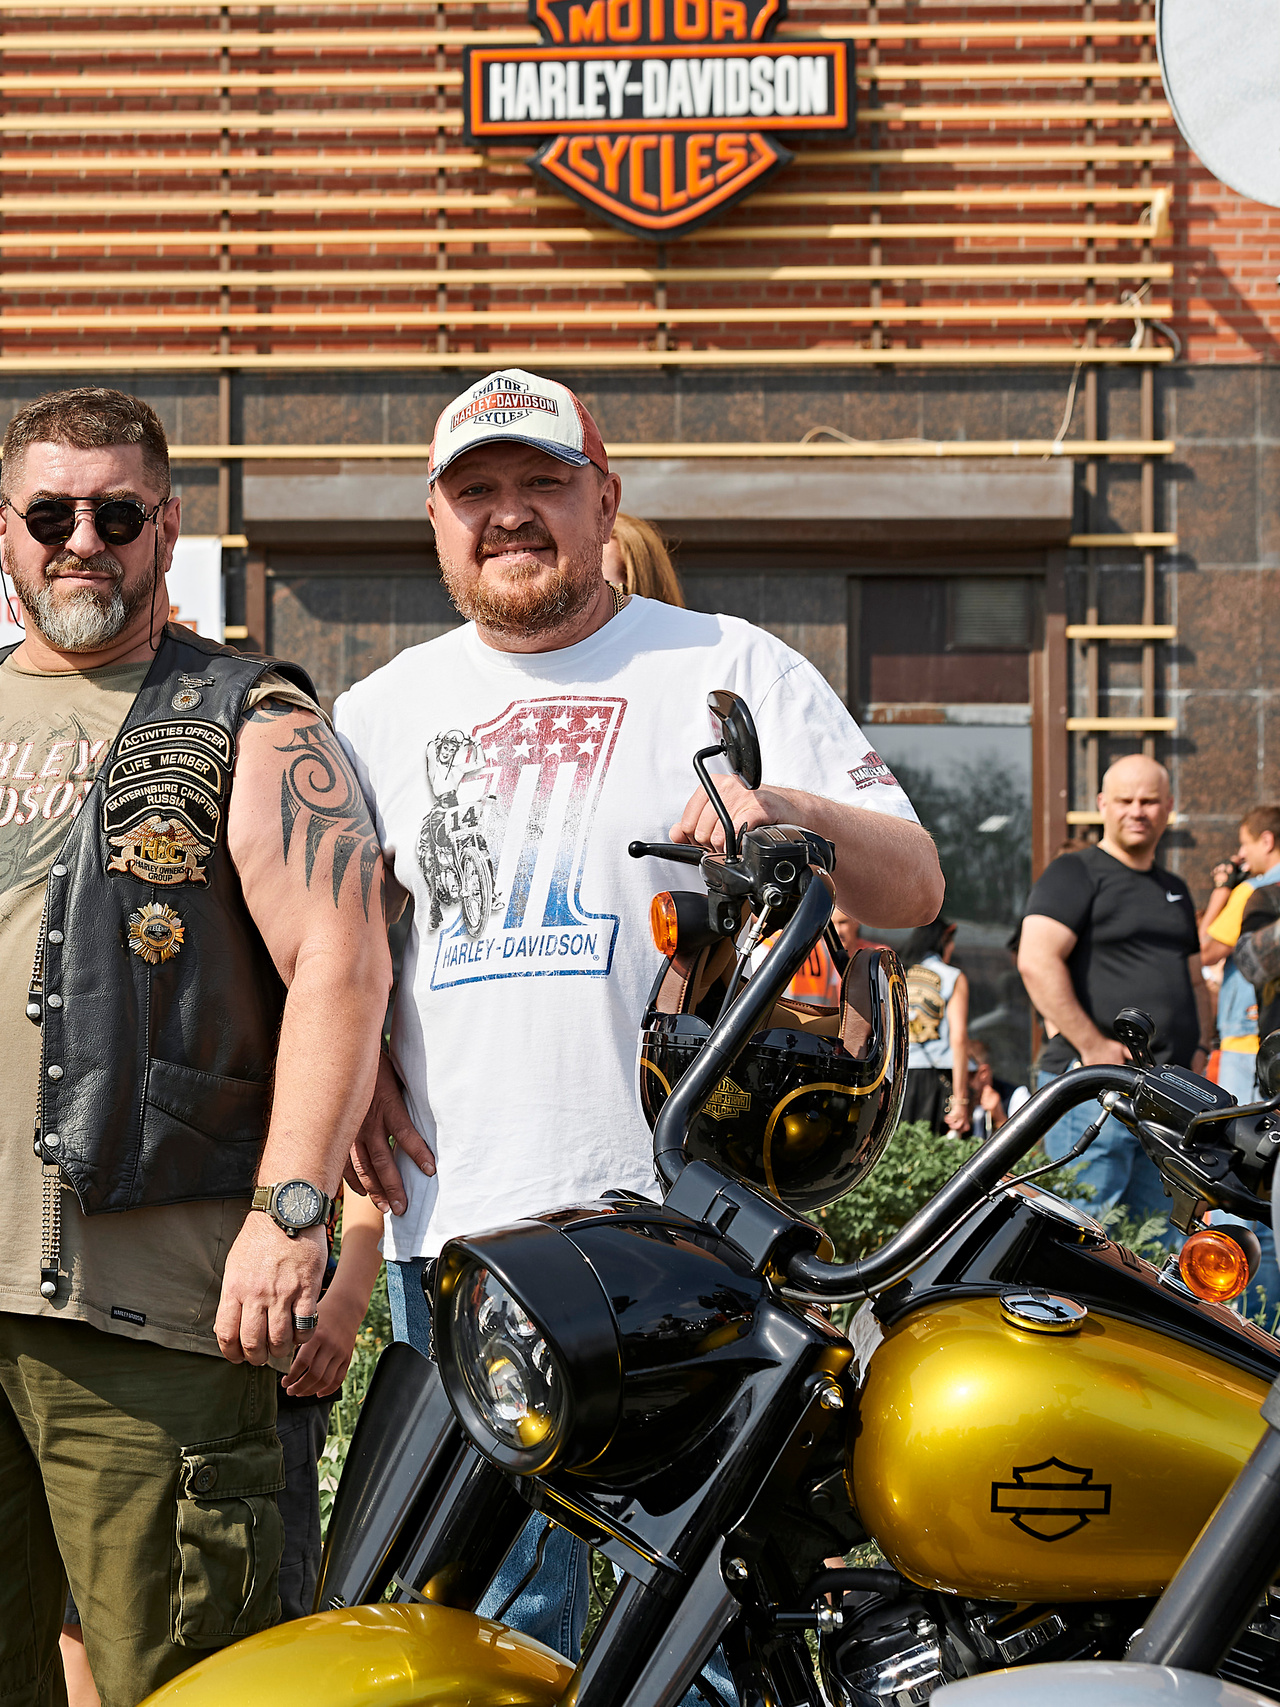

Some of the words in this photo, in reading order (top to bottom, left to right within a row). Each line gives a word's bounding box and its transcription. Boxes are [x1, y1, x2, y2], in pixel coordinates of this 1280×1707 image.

[570, 0, 747, 43] MOTOR
[488, 55, 828, 121] HARLEY-DAVIDSON
[568, 133, 748, 211] CYCLES
[478, 378, 522, 396] MOTOR
[453, 394, 556, 427] HARLEY-DAVIDSON
[478, 410, 524, 425] CYCLES
[123, 726, 183, 748] ACTIVITIES
[184, 726, 226, 749] OFFICER
[121, 757, 153, 776] LIFE
[159, 753, 211, 775] MEMBER
[107, 783, 179, 812] EKATERINBURG
[180, 786, 219, 821] CHAPTER
[146, 794, 186, 810] RUSSIA
[451, 805, 478, 832] 14
[135, 859, 158, 873] HARLEY
[148, 872, 173, 882] GROUP
[442, 933, 598, 969] HARLEY-DAVIDSON
